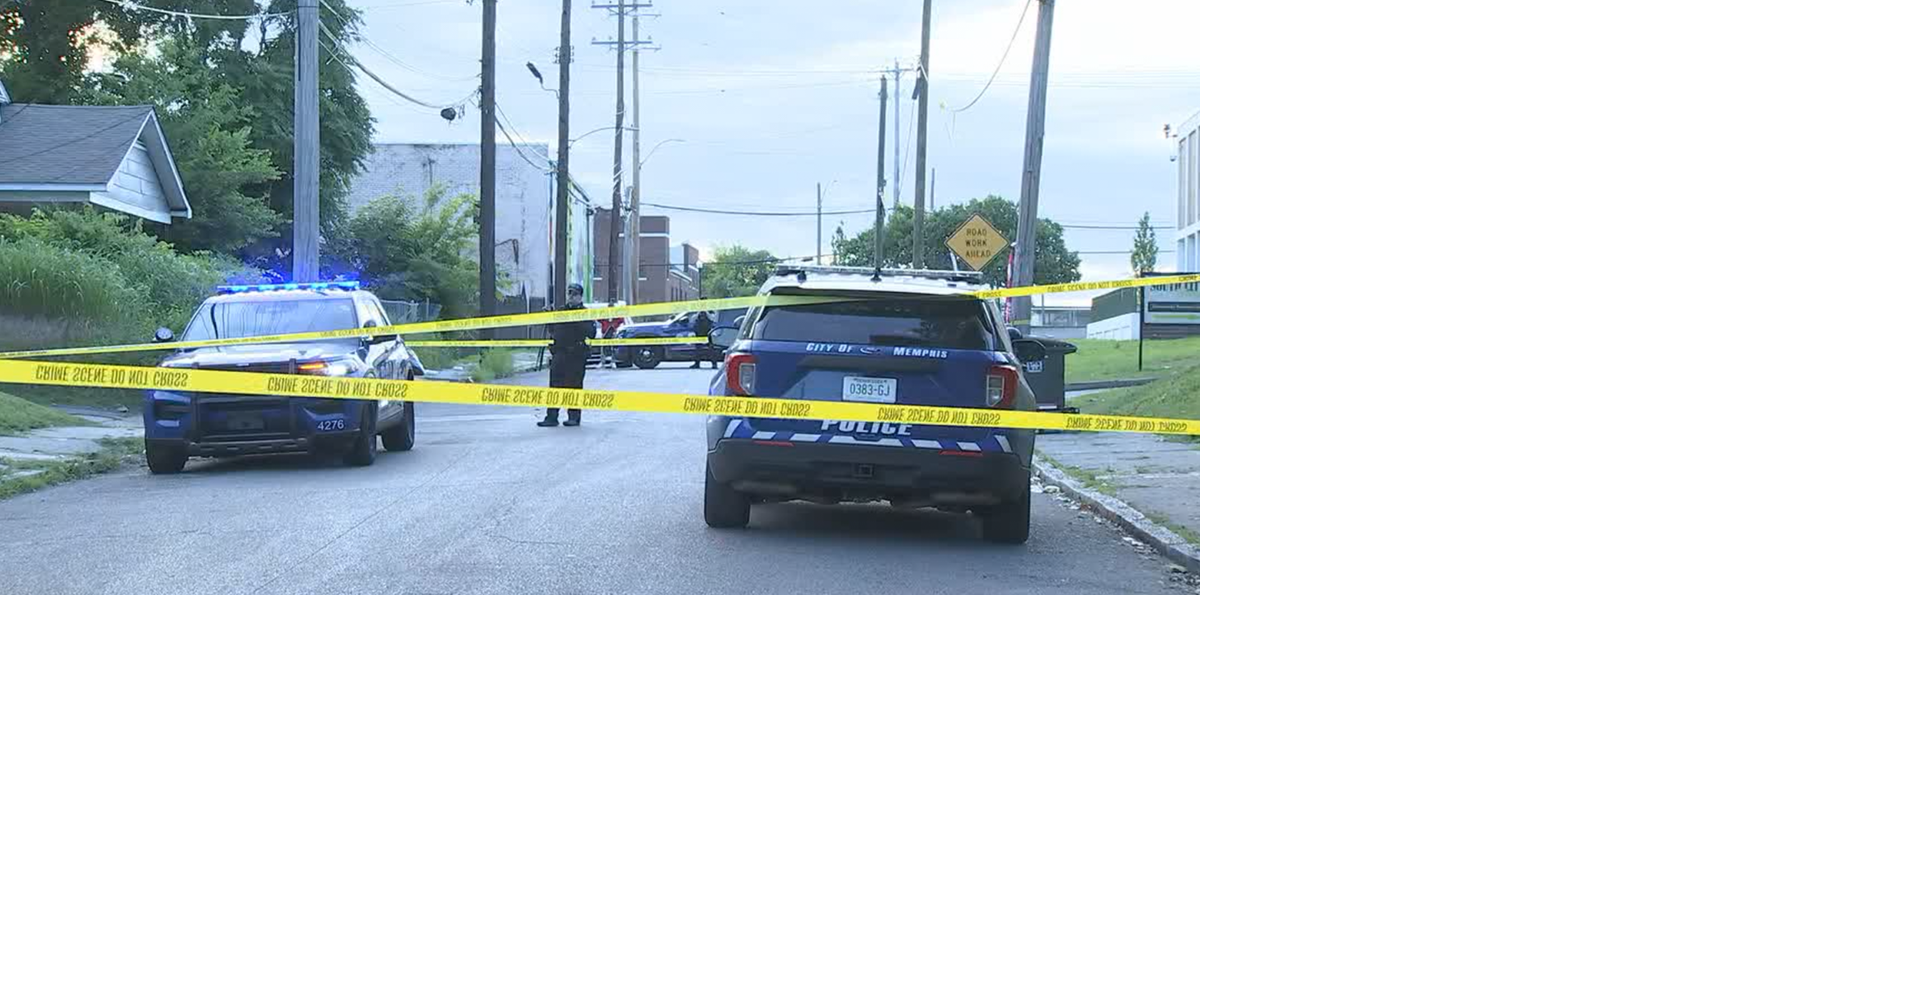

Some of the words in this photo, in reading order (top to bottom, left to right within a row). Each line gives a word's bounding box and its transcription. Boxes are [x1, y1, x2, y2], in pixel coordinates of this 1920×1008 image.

[966, 228, 987, 236] ROAD
[965, 239, 987, 247] WORK
[965, 249, 991, 258] AHEAD
[806, 343, 834, 352] CITY
[838, 344, 853, 353] OF
[893, 347, 948, 358] MEMPHIS
[850, 383, 890, 396] 0383-GJ
[317, 419, 344, 431] 4276
[821, 419, 912, 435] POLICE
